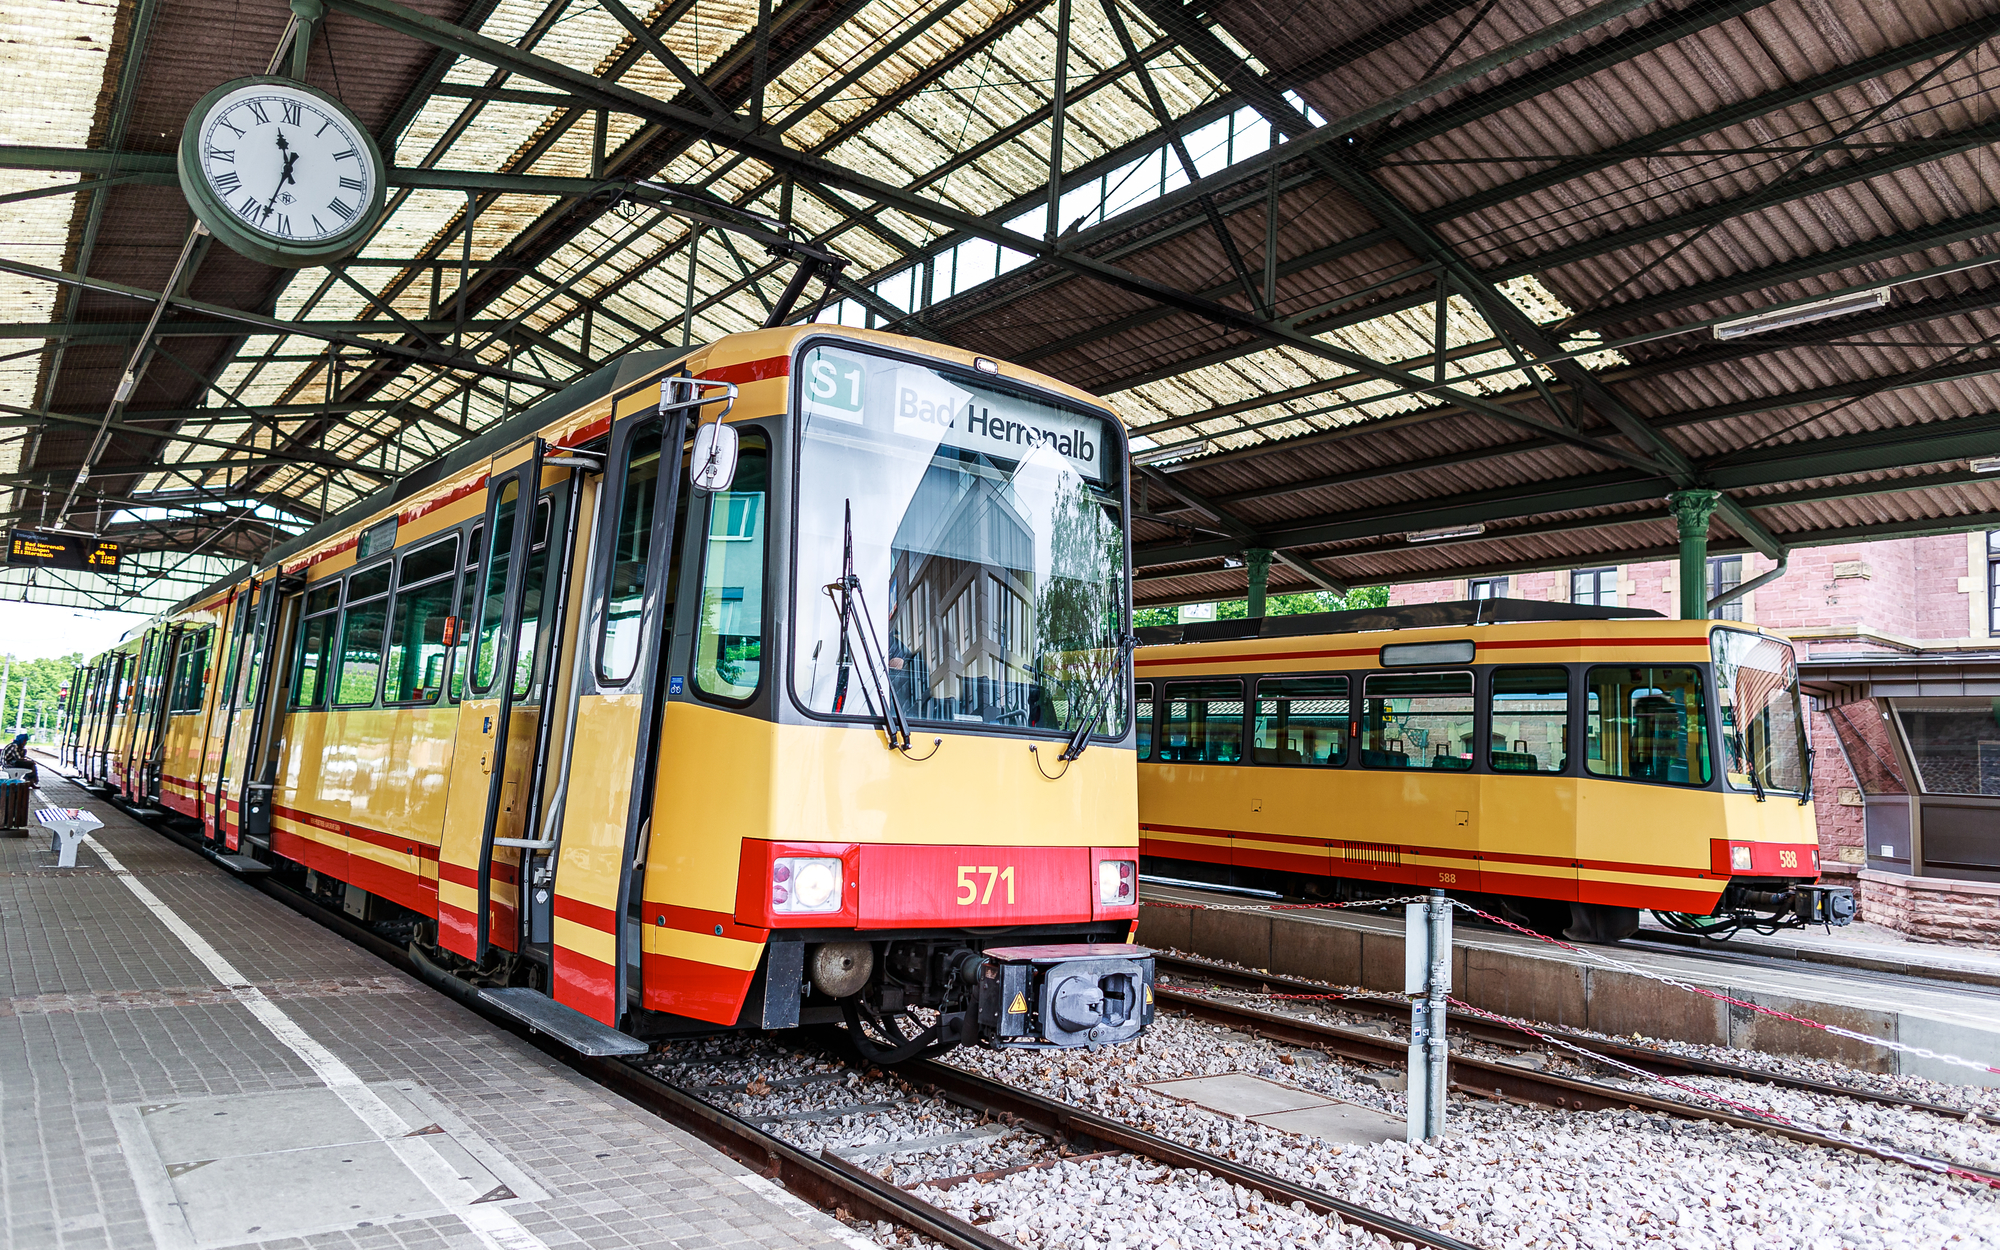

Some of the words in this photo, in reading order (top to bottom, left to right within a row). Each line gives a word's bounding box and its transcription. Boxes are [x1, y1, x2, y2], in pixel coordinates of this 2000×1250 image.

[247, 102, 271, 126] XI
[280, 103, 302, 127] XII
[808, 358, 861, 407] S1
[900, 387, 955, 429] Bad
[968, 404, 1095, 462] Herrenalb
[1779, 850, 1798, 869] 588
[956, 865, 1015, 906] 571
[1439, 872, 1457, 884] 588
